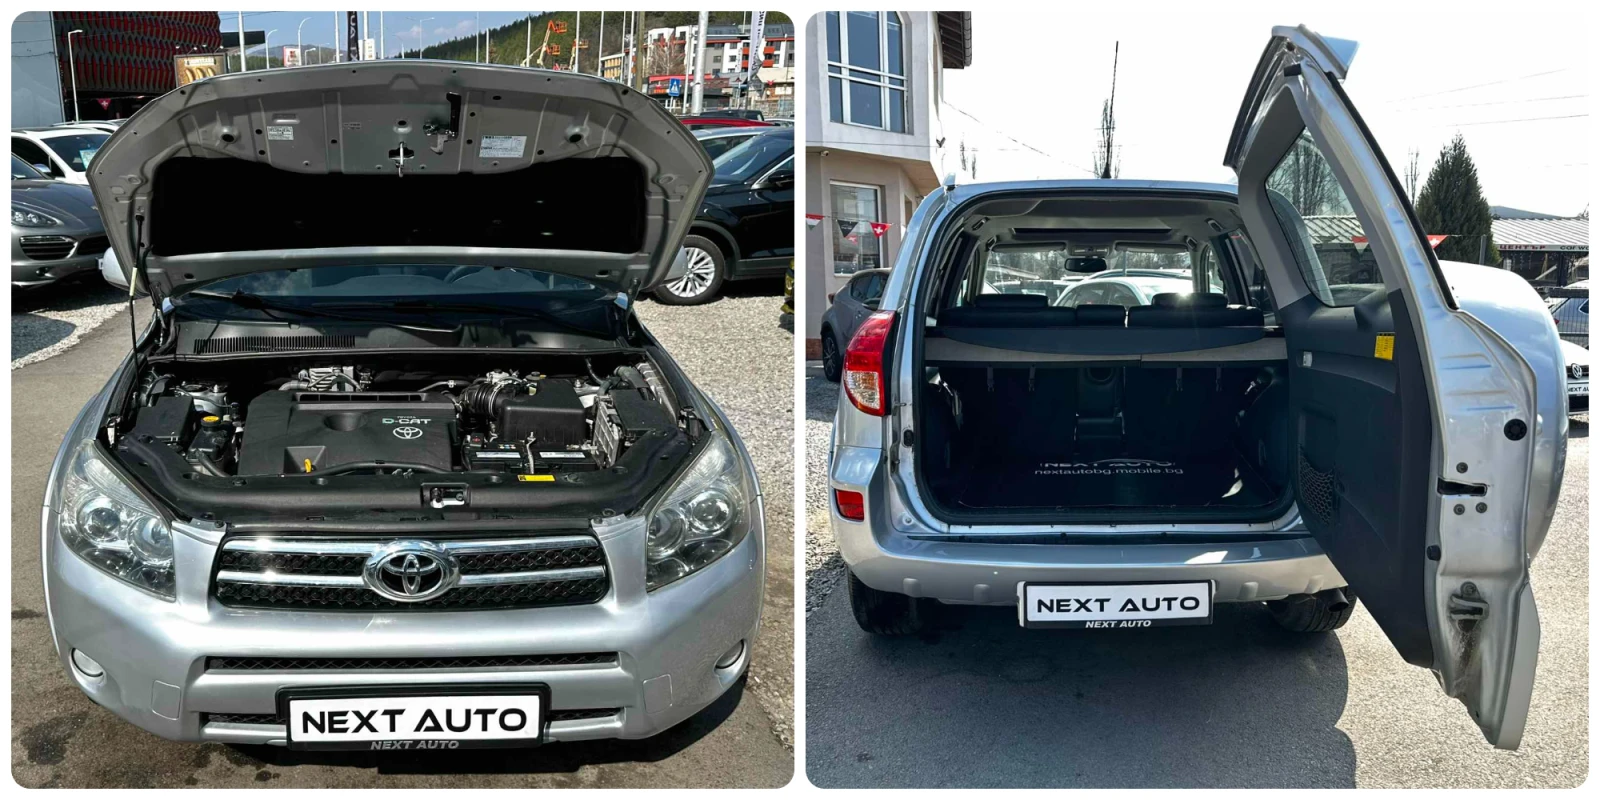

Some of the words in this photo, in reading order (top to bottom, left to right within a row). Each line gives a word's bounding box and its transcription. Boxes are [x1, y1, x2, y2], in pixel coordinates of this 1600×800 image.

[1037, 598, 1111, 613] NEXT
[1118, 596, 1200, 612] AUTO
[1085, 620, 1116, 629] NEXT
[1119, 619, 1152, 628] AUTO
[302, 708, 405, 734] NEXT
[413, 708, 527, 733] AUTO
[370, 740, 413, 750] NEXT
[416, 740, 459, 749] AUTO
